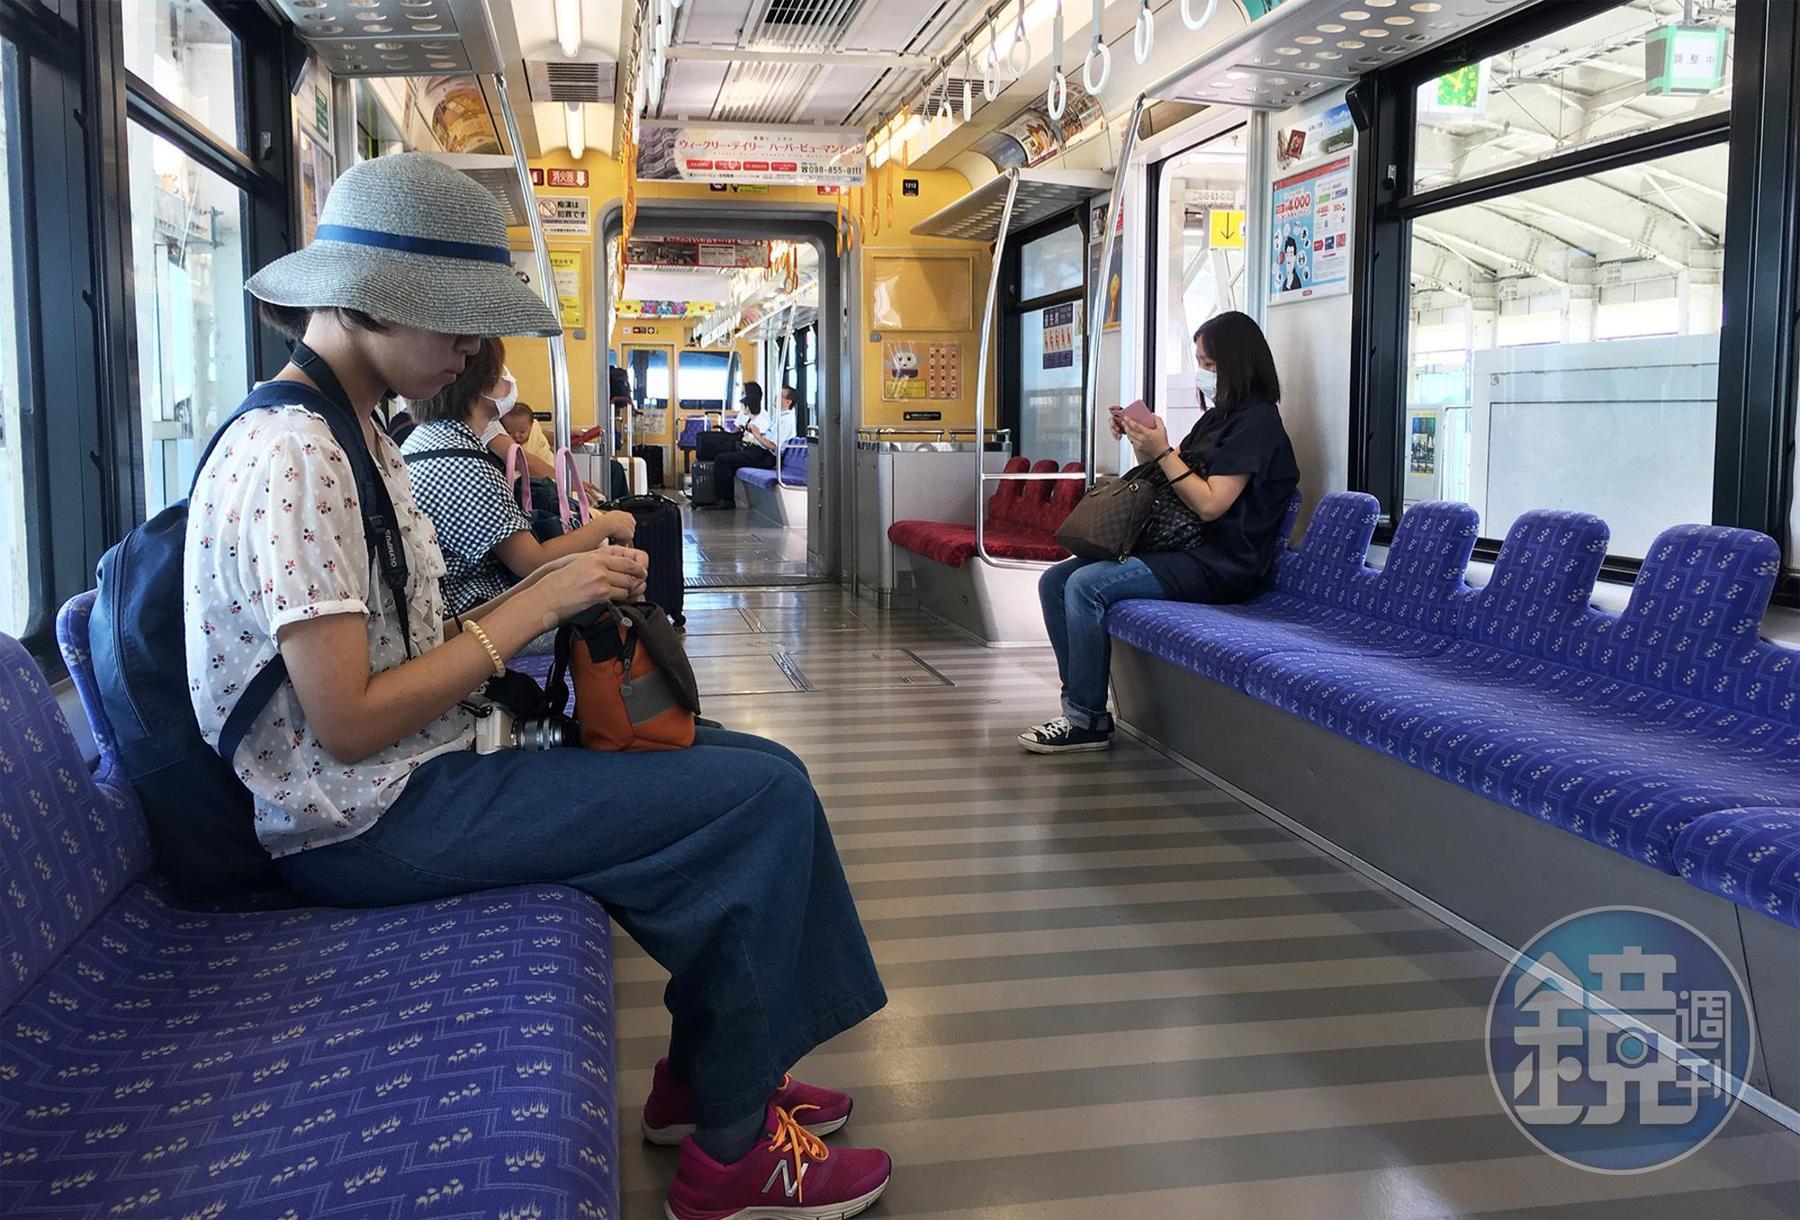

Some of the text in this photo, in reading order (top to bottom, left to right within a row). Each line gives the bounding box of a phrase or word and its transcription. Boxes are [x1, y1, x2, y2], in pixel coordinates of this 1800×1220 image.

[1674, 53, 1716, 65] 調整中
[552, 170, 574, 183] 消火器
[385, 529, 397, 568] OLYMPUS
